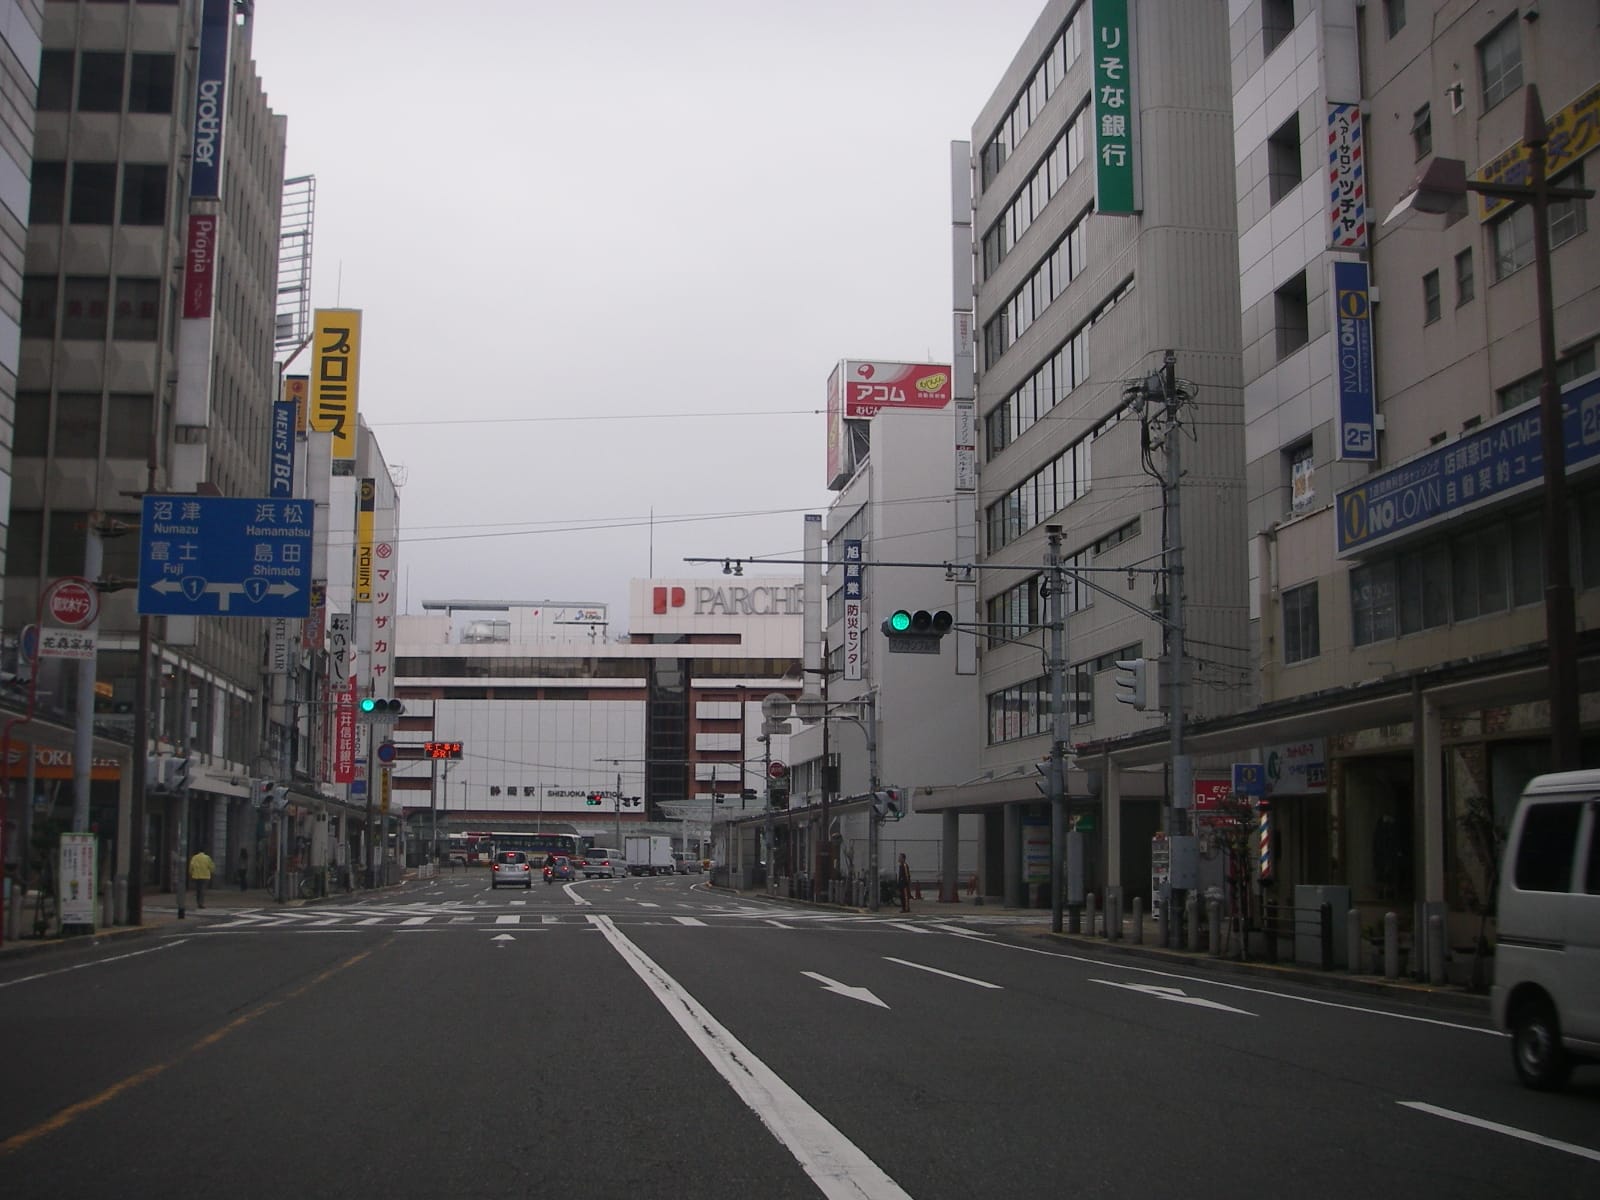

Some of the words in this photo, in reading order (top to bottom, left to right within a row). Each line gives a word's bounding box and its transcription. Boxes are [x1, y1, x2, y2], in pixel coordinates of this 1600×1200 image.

[1099, 26, 1126, 167] りそな銀行
[195, 79, 222, 168] brother
[1338, 116, 1351, 175] ヘアーサロン
[1339, 180, 1356, 232] ツチヤ
[193, 219, 213, 274] Propia
[319, 327, 351, 441] プロミス
[856, 385, 906, 402] アコム
[274, 409, 289, 450] MEN'S
[1346, 428, 1370, 446] 2F
[273, 453, 292, 493] TBC
[152, 501, 201, 521] 沼津
[255, 503, 304, 524] 浜松
[153, 523, 199, 535] Numazu
[246, 525, 311, 537] Hamamatsu
[150, 541, 199, 561] 富士
[254, 542, 301, 563] 島田
[163, 562, 184, 577] Fuji
[253, 564, 301, 577] Shimada
[359, 546, 371, 588] プロミス
[846, 545, 859, 595] 旭産業
[190, 580, 197, 594] 1
[253, 583, 260, 596] 1
[373, 568, 390, 678] マツザカヤ
[847, 604, 859, 676] 防災センター
[274, 643, 285, 671] HAIR
[490, 785, 535, 797] 静岡駅
[547, 790, 586, 798] SHIZUOKA
